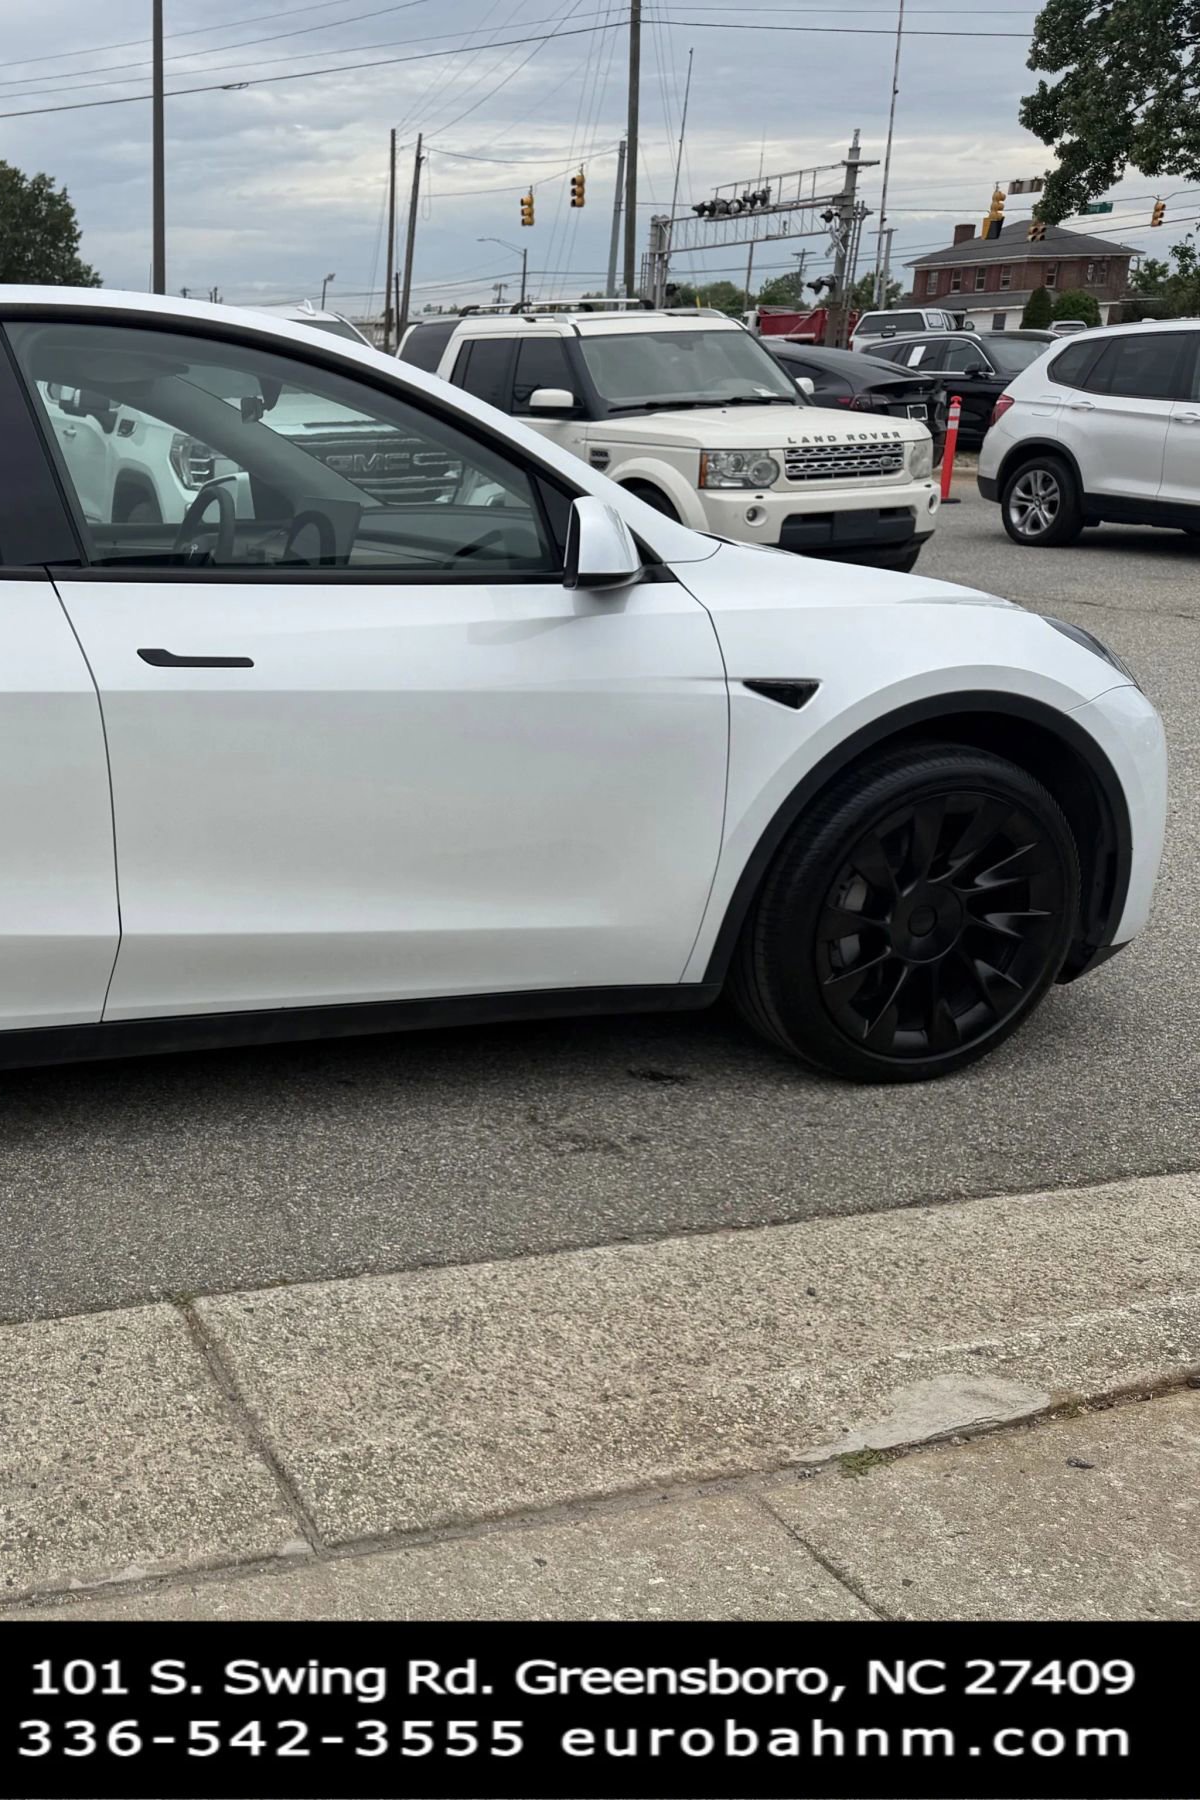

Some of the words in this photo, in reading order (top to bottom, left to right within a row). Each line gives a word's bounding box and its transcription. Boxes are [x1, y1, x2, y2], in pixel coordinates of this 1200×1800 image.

[788, 435, 837, 444] LAND
[847, 431, 901, 441] ROVER
[326, 452, 410, 472] GMC
